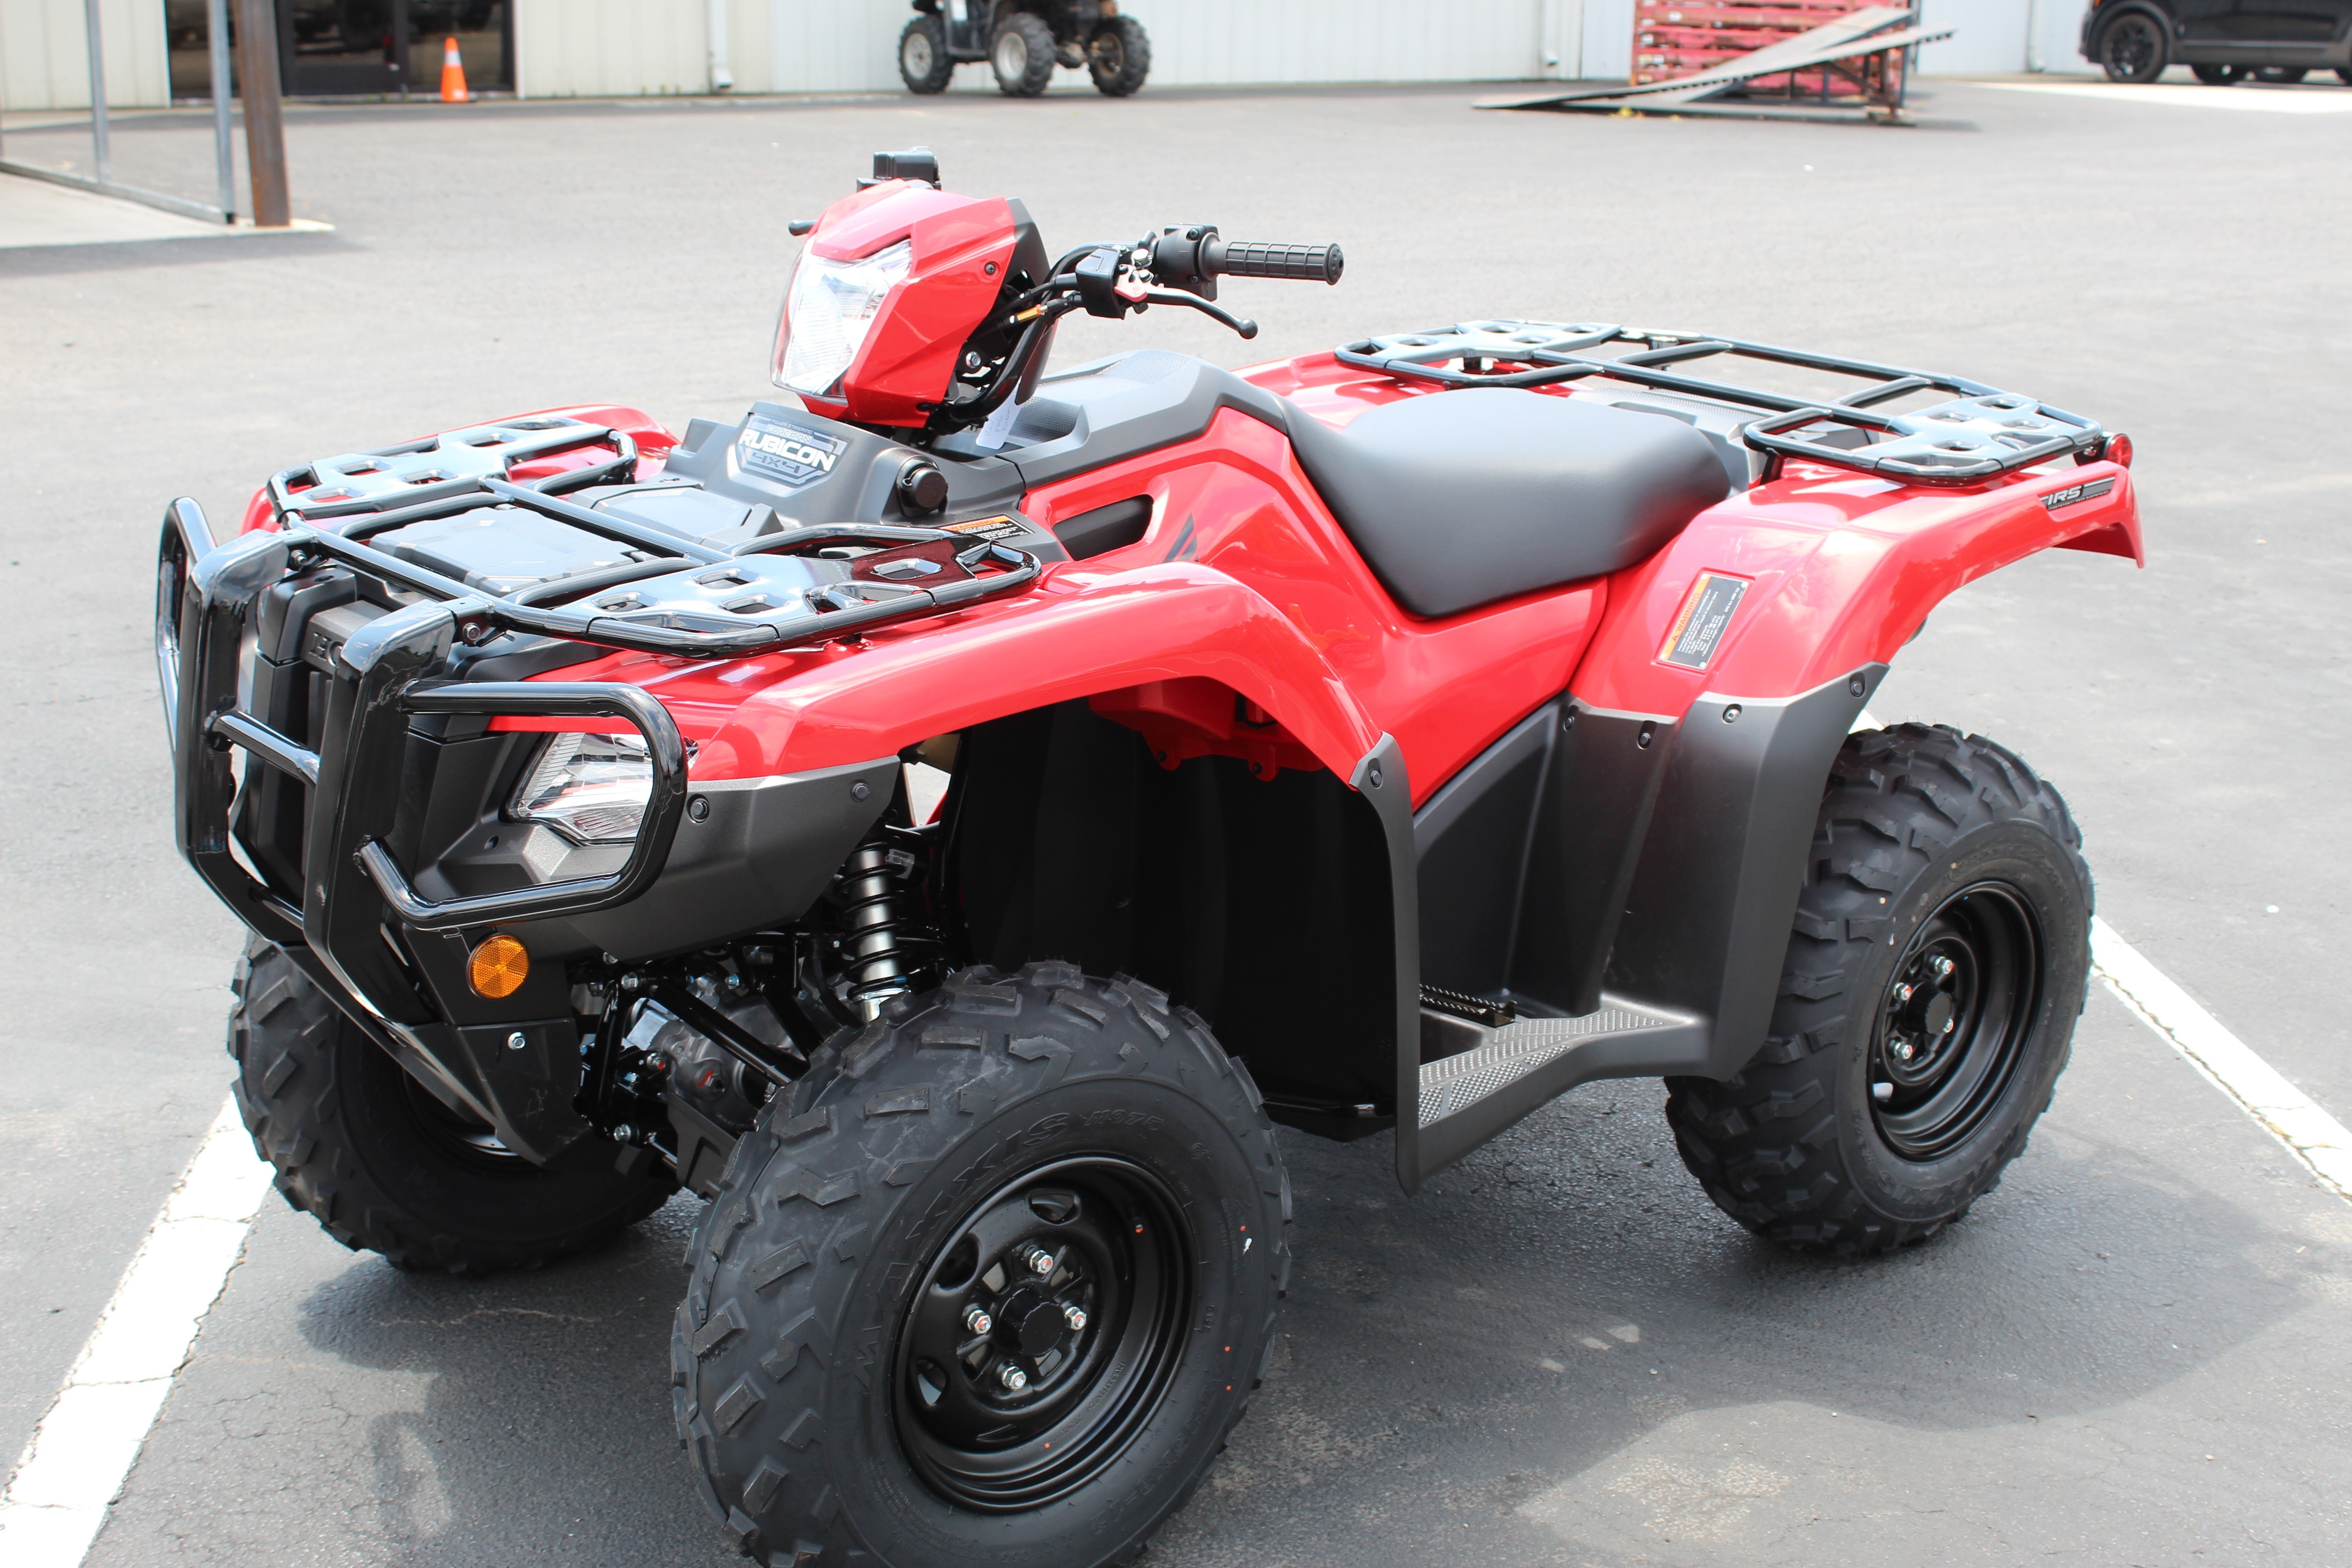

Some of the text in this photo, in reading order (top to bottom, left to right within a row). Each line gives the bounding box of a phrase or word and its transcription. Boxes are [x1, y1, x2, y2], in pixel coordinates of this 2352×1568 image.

[766, 424, 812, 444] FOREMAN
[771, 419, 813, 434] POWER STEERING
[738, 428, 836, 472] RUBICON
[2048, 485, 2082, 505] IRS
[948, 520, 996, 530] WARNING
[1676, 593, 1701, 632] WARNING
[1084, 1109, 1164, 1131] M975
[853, 1112, 1070, 1393] MAXXIS
